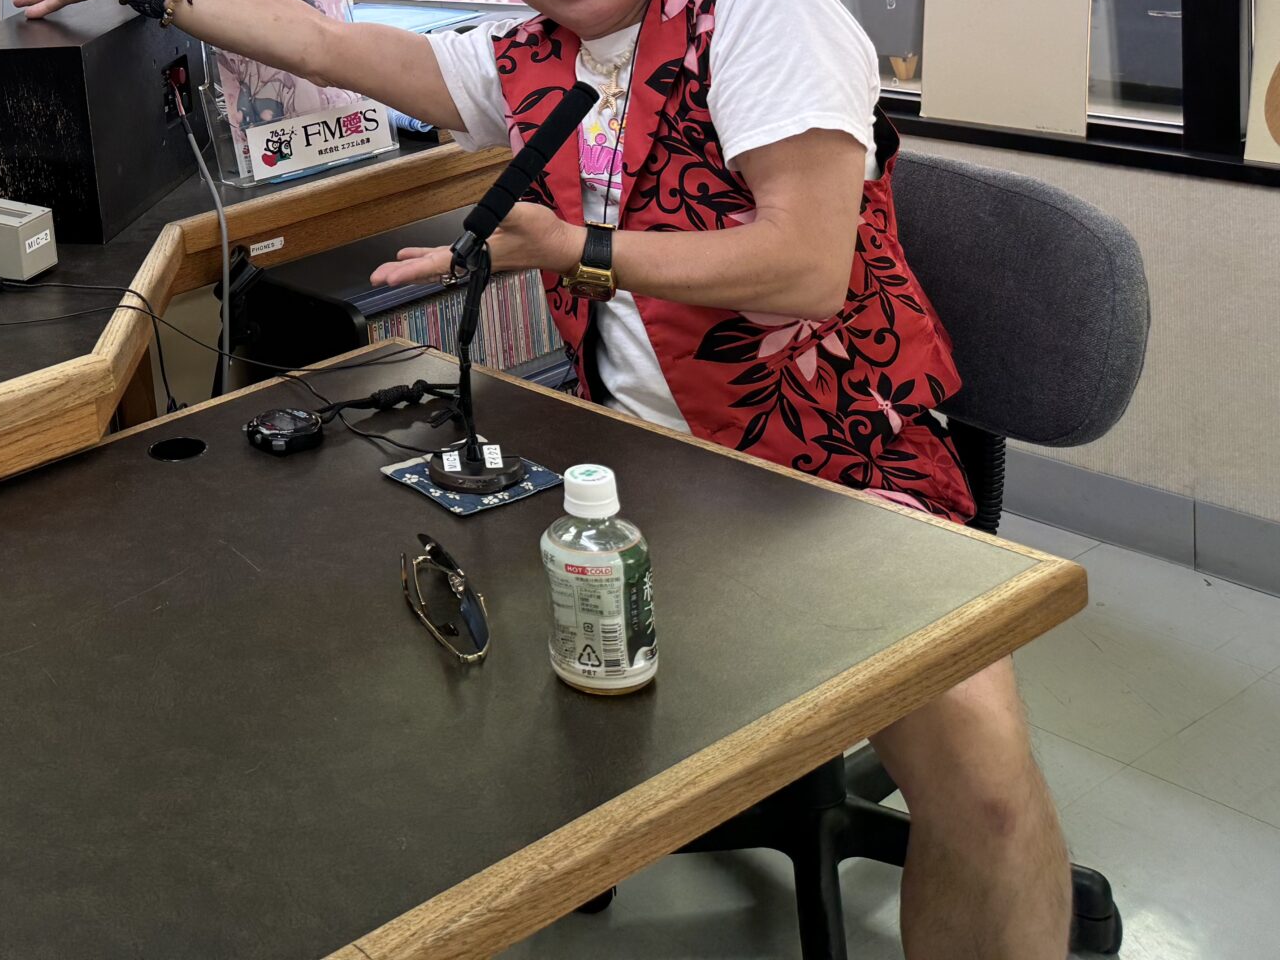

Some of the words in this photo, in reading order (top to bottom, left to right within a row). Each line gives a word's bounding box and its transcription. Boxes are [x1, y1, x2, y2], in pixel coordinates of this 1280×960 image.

[318, 145, 340, 156] 株式会社
[341, 137, 371, 150] エフエム会津
[27, 232, 49, 250] MIC-2
[252, 242, 275, 253] PHONES
[566, 565, 583, 574] HOT
[582, 669, 597, 677] PET
